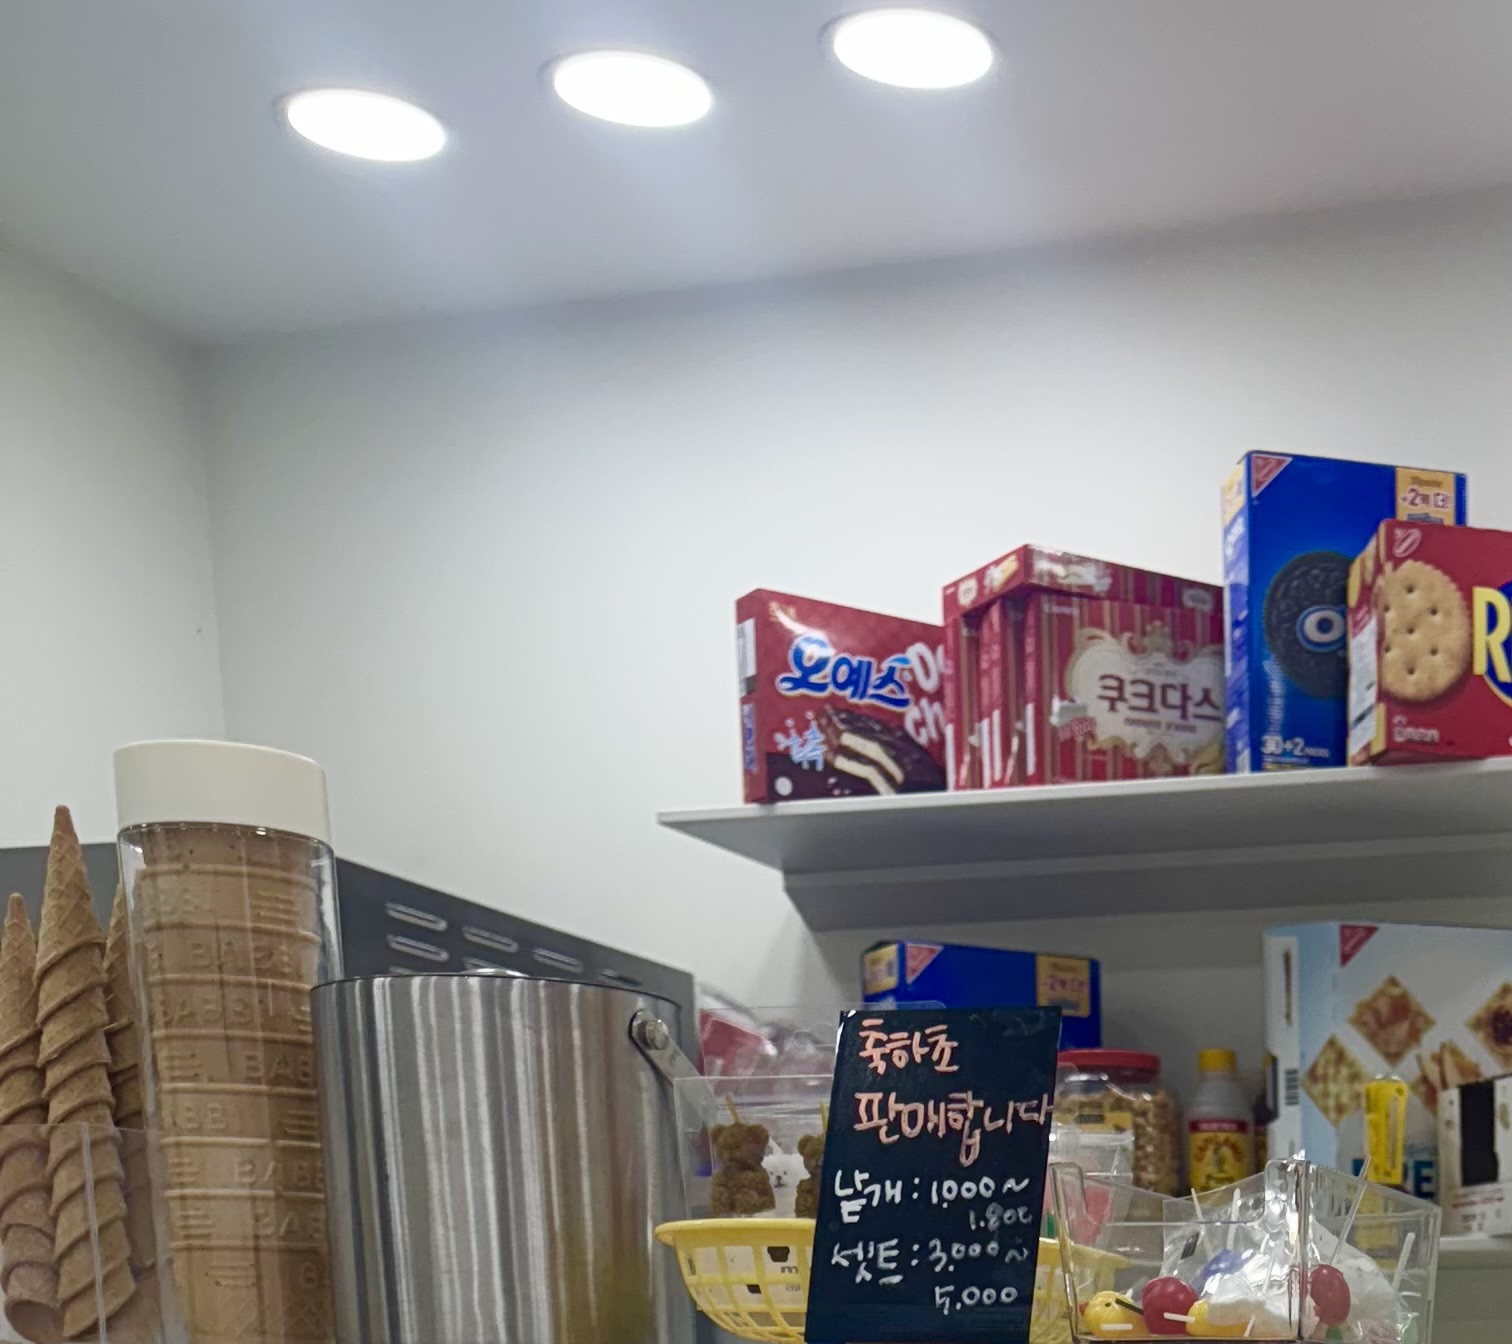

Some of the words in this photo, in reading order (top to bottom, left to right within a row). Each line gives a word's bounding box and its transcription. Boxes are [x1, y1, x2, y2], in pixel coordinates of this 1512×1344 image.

[777, 635, 912, 711] 오예스
[1097, 673, 1222, 722] 쿠크다스
[858, 1017, 961, 1075] 축하초
[852, 1090, 1054, 1168] 판매합니다
[834, 1168, 902, 1223] 낱개
[831, 1238, 904, 1285] 셋트
